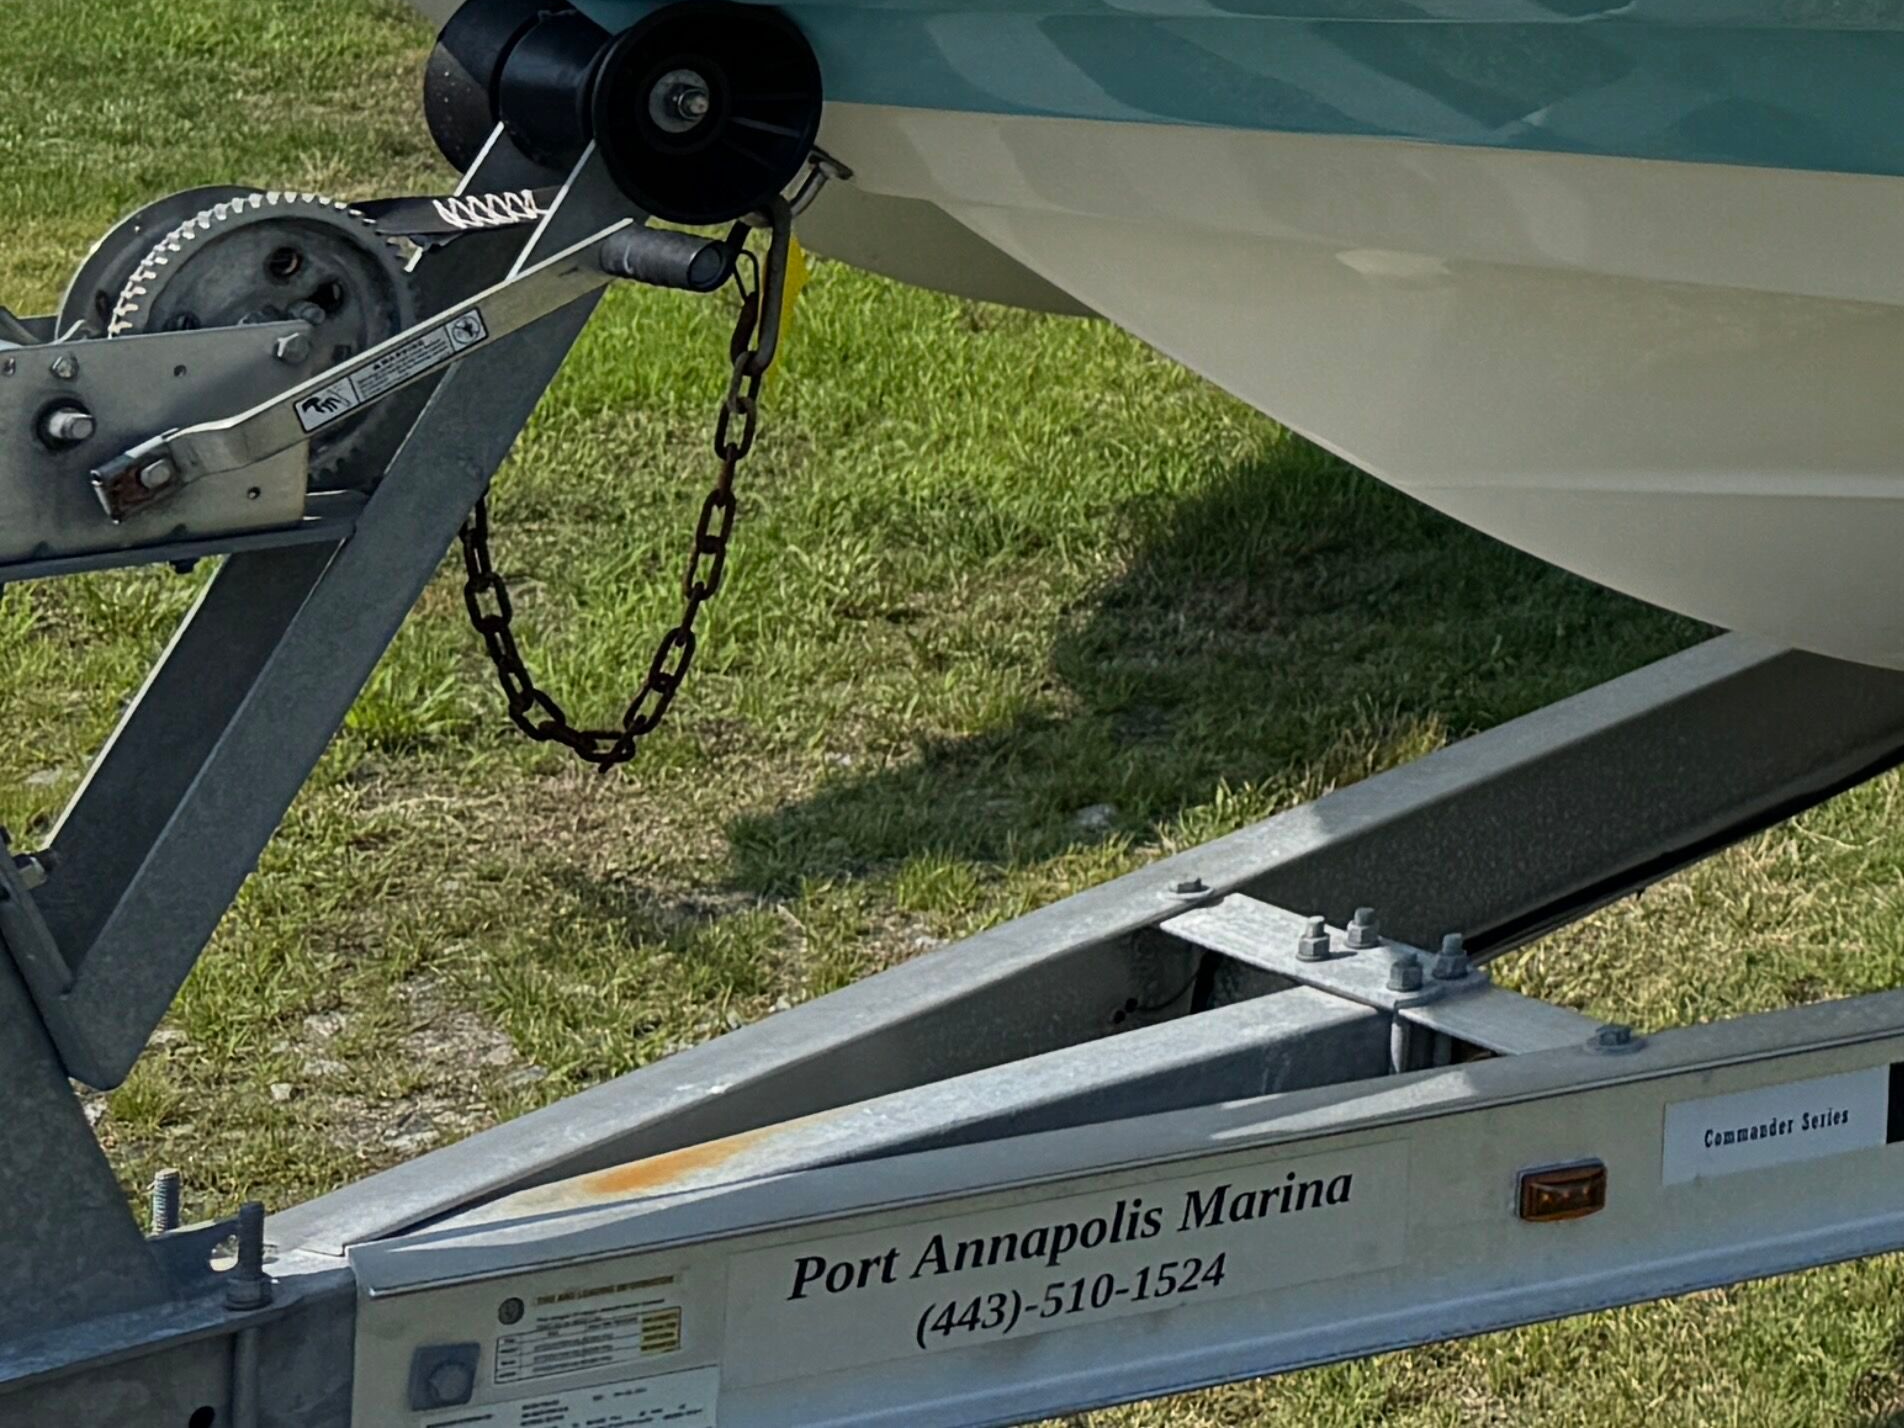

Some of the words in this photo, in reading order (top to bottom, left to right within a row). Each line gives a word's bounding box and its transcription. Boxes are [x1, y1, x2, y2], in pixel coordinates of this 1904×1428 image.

[1705, 1118, 1793, 1148] Commander
[1802, 1110, 1848, 1130] Series
[787, 1244, 901, 1301] Port
[911, 1197, 1164, 1280] Annapolis
[1177, 1171, 1355, 1233] Marina
[915, 1250, 1227, 1349] (443)-510-1524
